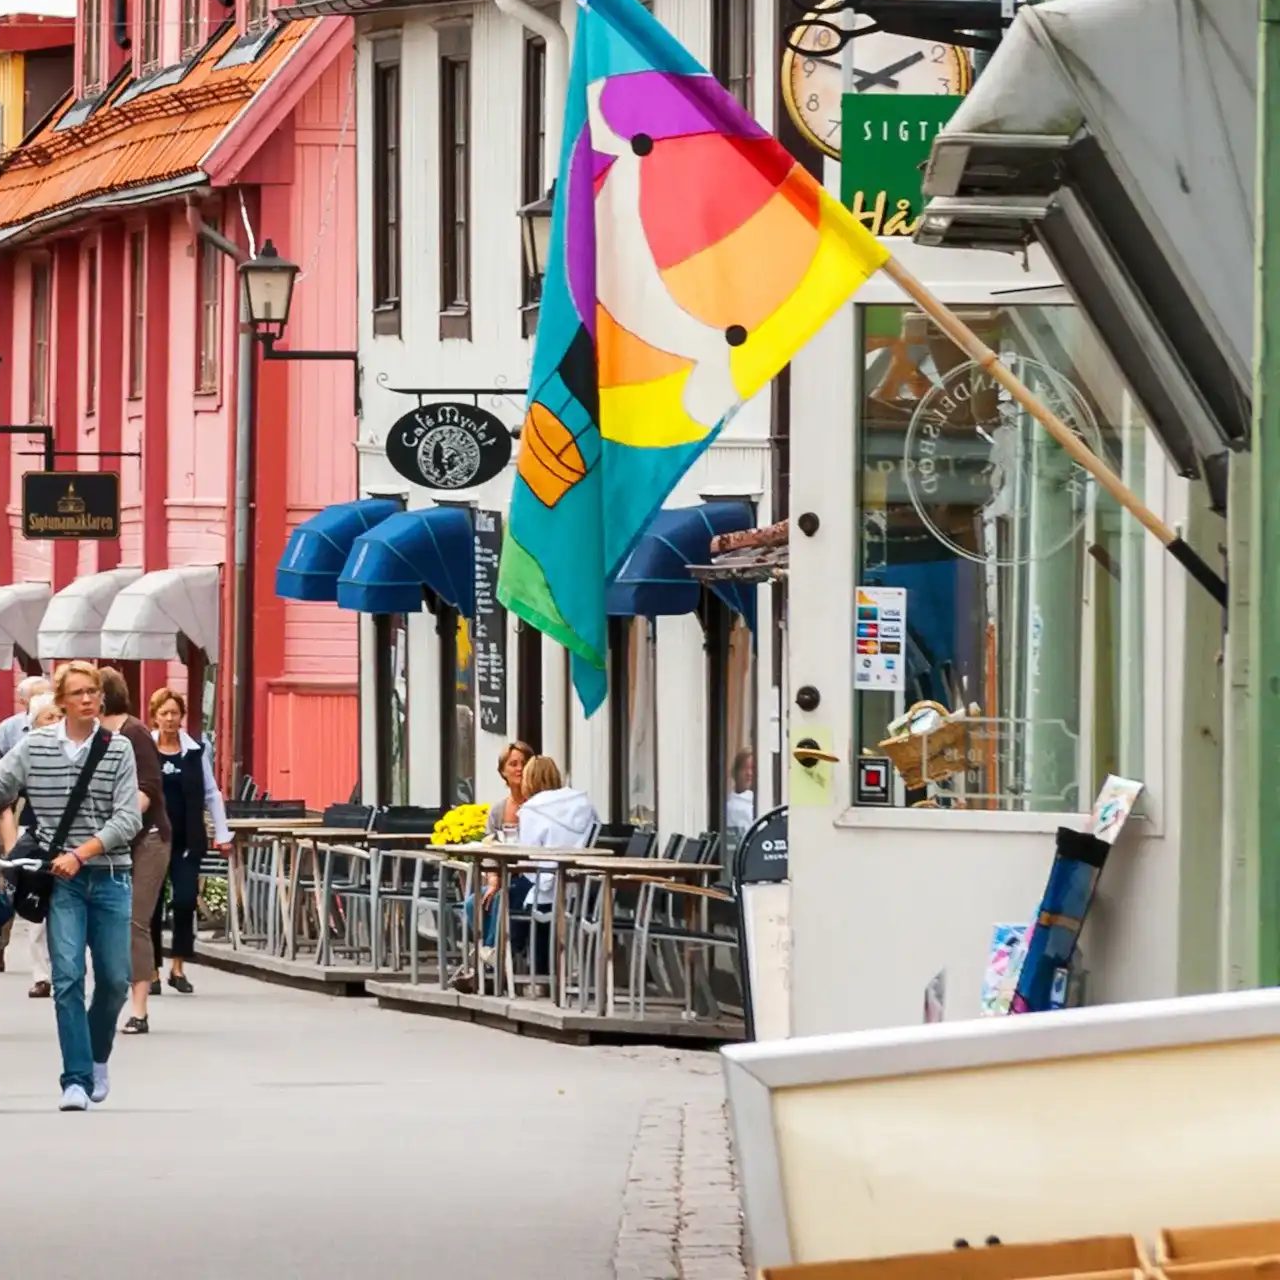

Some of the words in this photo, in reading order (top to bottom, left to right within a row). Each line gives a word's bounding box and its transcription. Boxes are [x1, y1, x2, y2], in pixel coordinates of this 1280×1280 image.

[931, 44, 946, 63] 2
[803, 60, 817, 78] 9
[806, 93, 820, 112] 8
[402, 413, 435, 447] Café
[437, 406, 496, 447] Myntet
